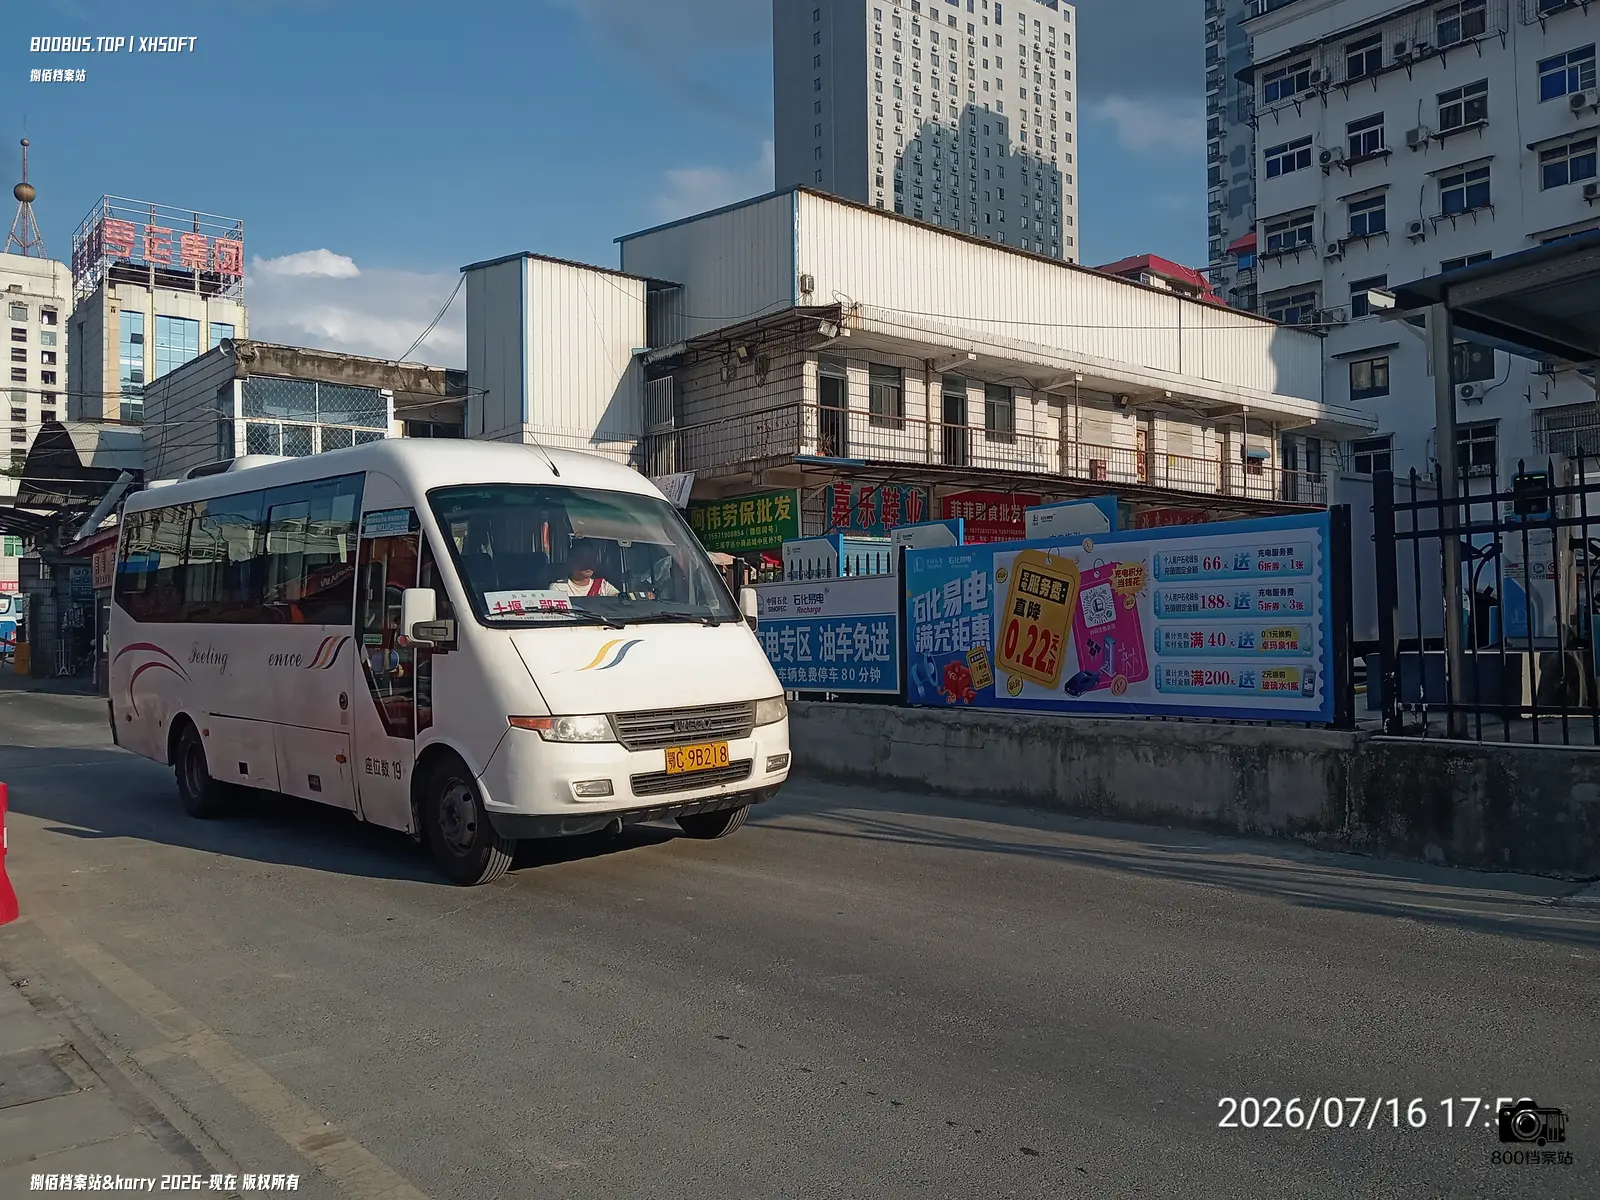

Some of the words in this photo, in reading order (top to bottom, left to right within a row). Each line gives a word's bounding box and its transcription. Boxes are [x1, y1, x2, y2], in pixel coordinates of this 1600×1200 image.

[104, 217, 243, 276] 亨运集团
[691, 495, 792, 531] 阿伟劳保批发
[831, 481, 923, 530] 嘉乐鞋业
[1257, 547, 1294, 557] 充电服务费
[1233, 552, 1251, 571] 送
[1114, 567, 1143, 578] 充电积分
[1117, 576, 1140, 587] 当钱花
[766, 596, 788, 606] 中国石化
[793, 592, 824, 606] 石化易电
[913, 569, 988, 624] 石化易电
[1258, 587, 1294, 597] 充电服务费
[1234, 591, 1251, 610] 送
[796, 606, 822, 615] Recharge
[1013, 598, 1041, 621] 直降
[915, 612, 991, 653] 满充钜惠
[1165, 632, 1189, 640] 累计充电
[1238, 631, 1255, 648] 送
[1261, 630, 1292, 638] 0.1元换购
[819, 622, 890, 662] 油车免进
[1165, 640, 1190, 649] 实付金额
[1261, 640, 1298, 650] 卓玛泉1瓶
[188, 641, 228, 675] Feeling
[841, 668, 856, 681] 80
[858, 667, 881, 683] 分钟
[1165, 669, 1190, 677] 累计充电
[1239, 670, 1255, 688] 送
[1261, 671, 1286, 679] 2元换购
[1165, 678, 1190, 687] 实付金额
[1261, 681, 1299, 691] 玻璃水1瓶
[365, 757, 390, 777] 座位数
[392, 760, 402, 780] 19
